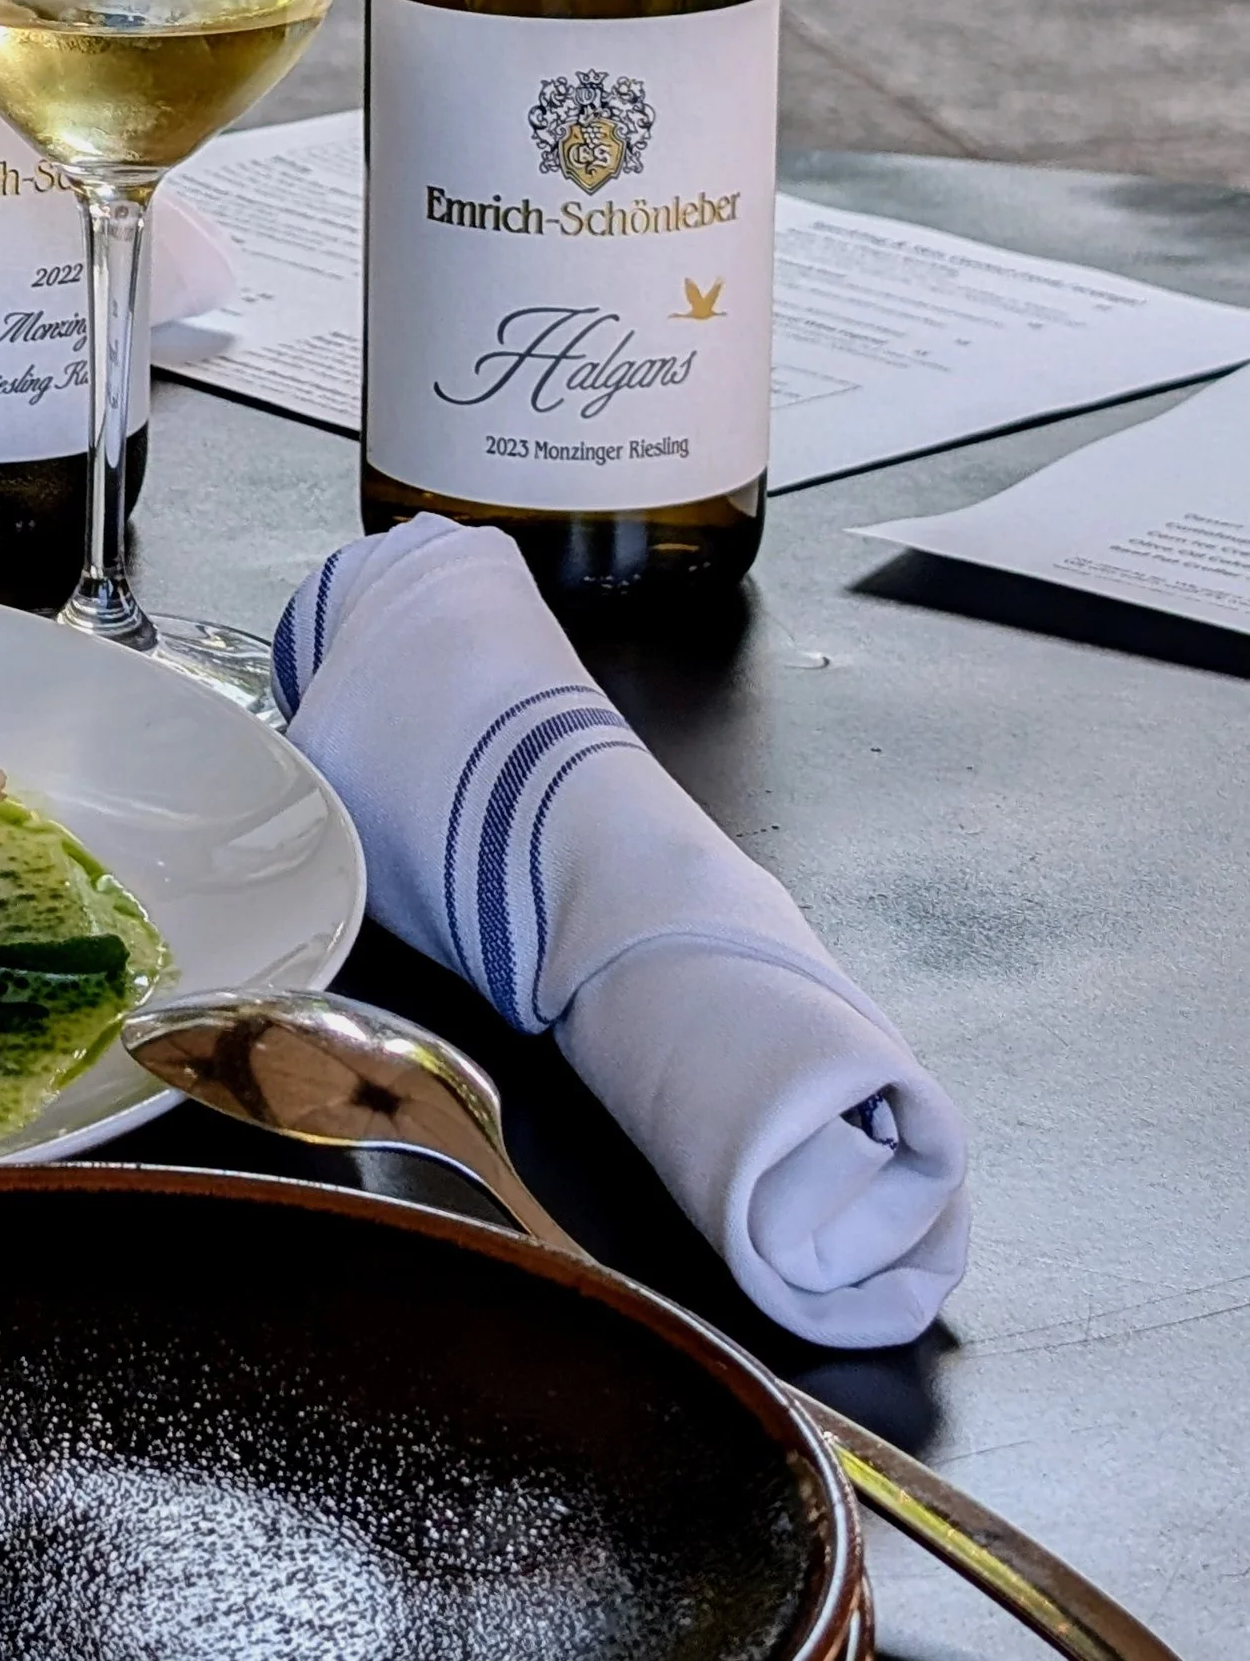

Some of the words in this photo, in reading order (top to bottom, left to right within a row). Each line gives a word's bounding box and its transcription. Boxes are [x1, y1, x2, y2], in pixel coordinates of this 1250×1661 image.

[426, 185, 741, 237] Emrich-Schönleber
[31, 262, 84, 288] 2022
[433, 307, 698, 420] Halgans
[485, 436, 530, 459] 2023
[533, 440, 624, 466] Monzinger
[628, 436, 690, 460] Riesling
